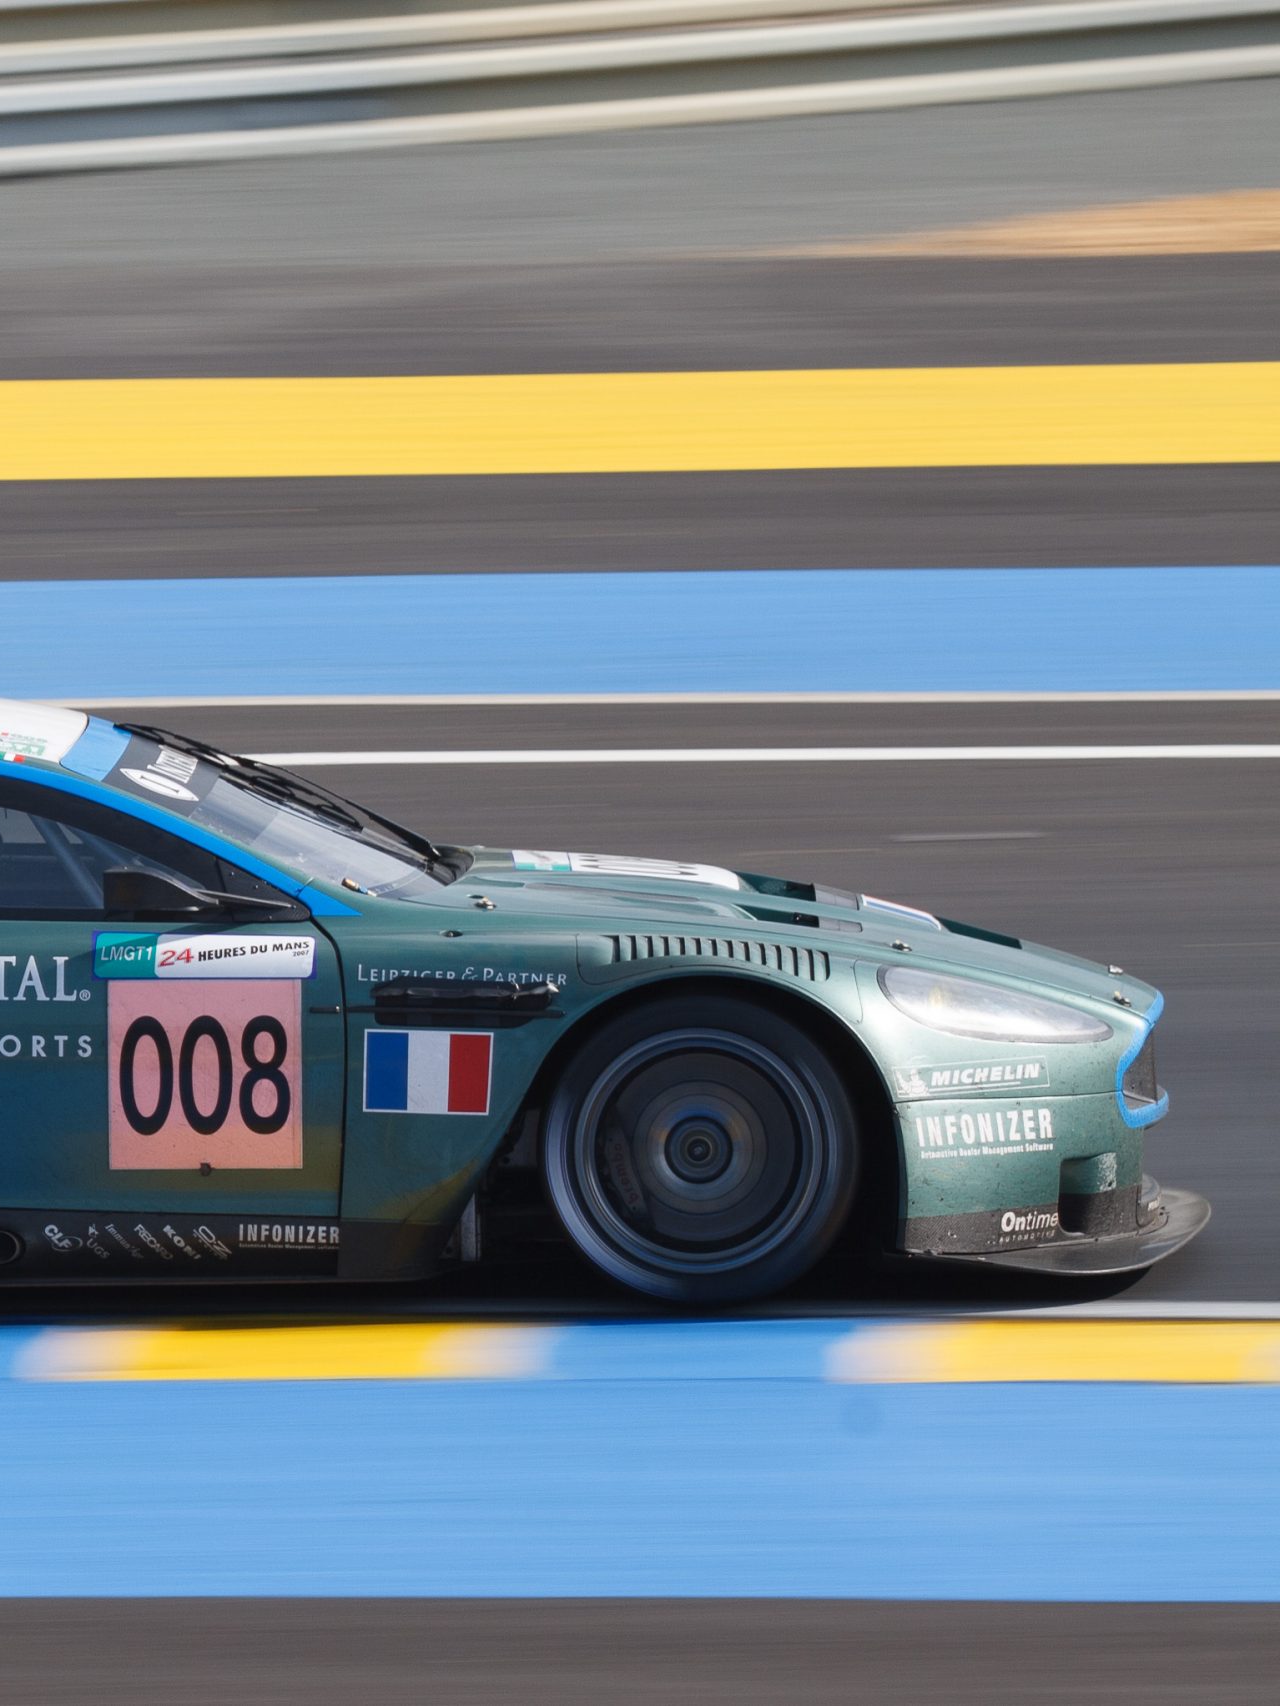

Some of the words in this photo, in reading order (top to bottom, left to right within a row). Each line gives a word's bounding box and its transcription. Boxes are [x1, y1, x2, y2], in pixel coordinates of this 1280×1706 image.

[100, 946, 153, 961] LMGT1
[158, 947, 194, 967] 24
[198, 947, 246, 961] HEURES
[251, 945, 268, 954] DU
[272, 941, 310, 952] MANS
[483, 967, 567, 986] PARTNER
[120, 1015, 291, 1136] 008
[930, 1062, 1041, 1087] MICHELIN
[915, 1107, 1054, 1148] INFONIZER
[982, 1144, 1024, 1156] Management
[1025, 1142, 1054, 1152] Software
[1001, 1210, 1059, 1233] Ontime
[238, 1223, 340, 1244] INFONIZER
